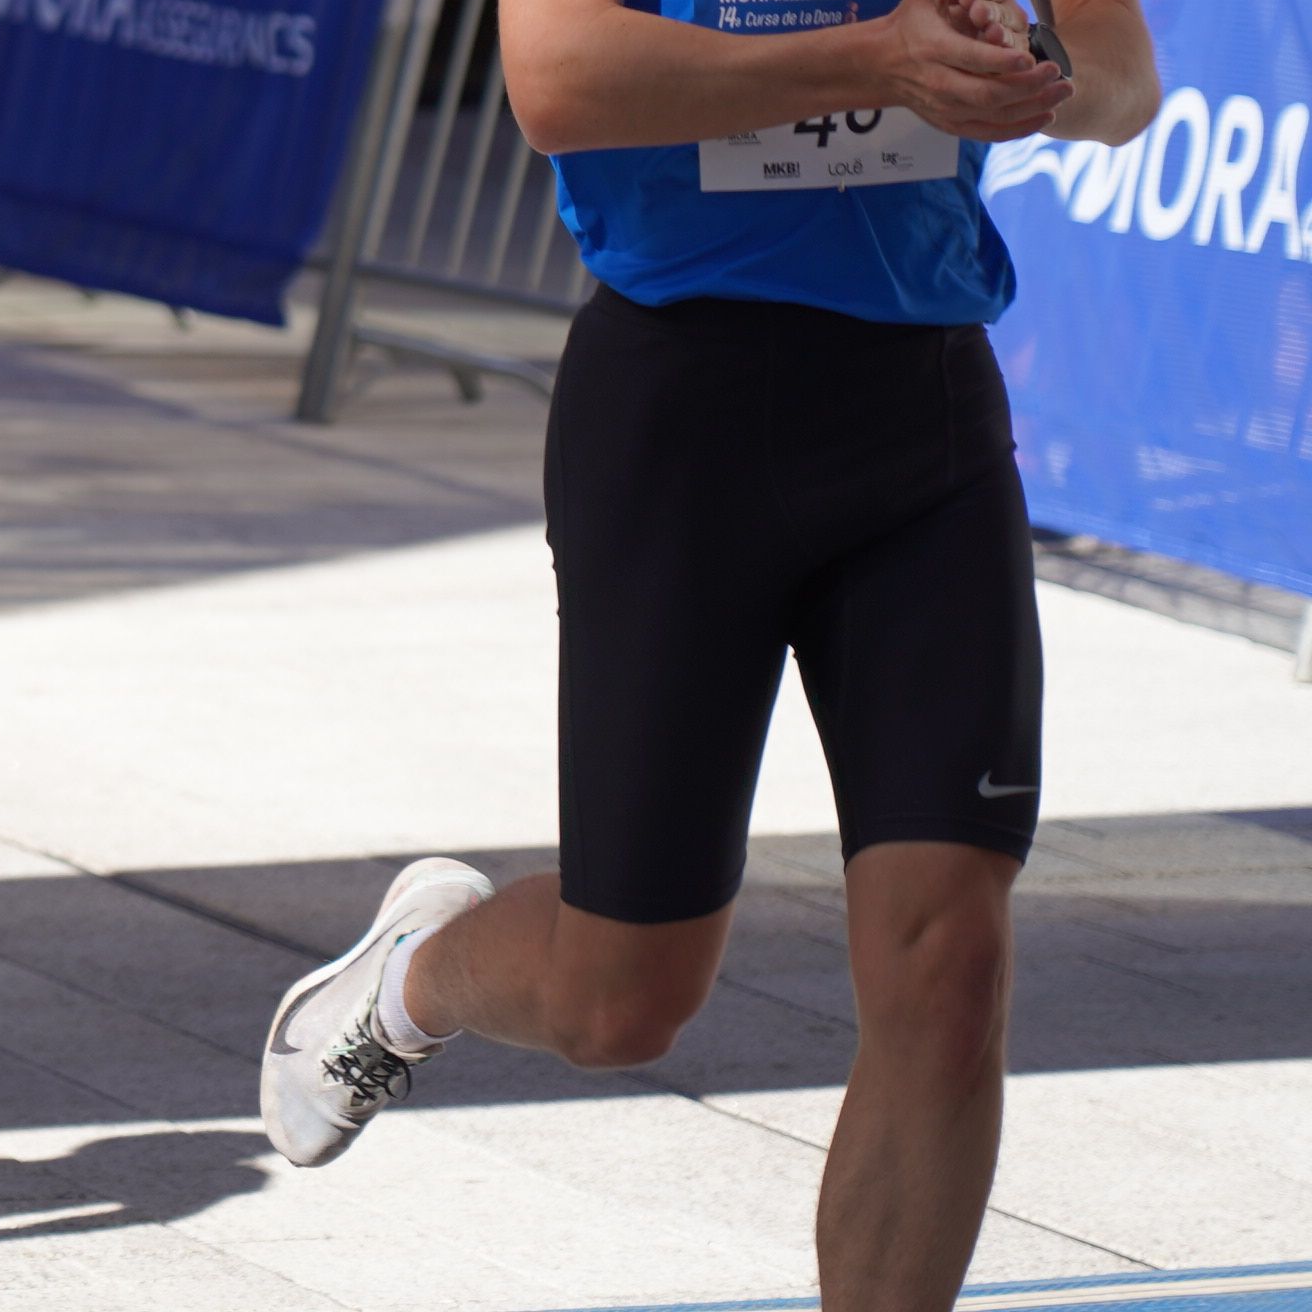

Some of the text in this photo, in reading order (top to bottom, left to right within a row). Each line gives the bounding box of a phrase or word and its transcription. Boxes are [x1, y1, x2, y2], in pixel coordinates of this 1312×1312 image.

[745, 11, 779, 27] Cursa
[782, 10, 797, 26] de
[815, 8, 842, 25] Dona
[1066, 86, 1311, 261] MORA
